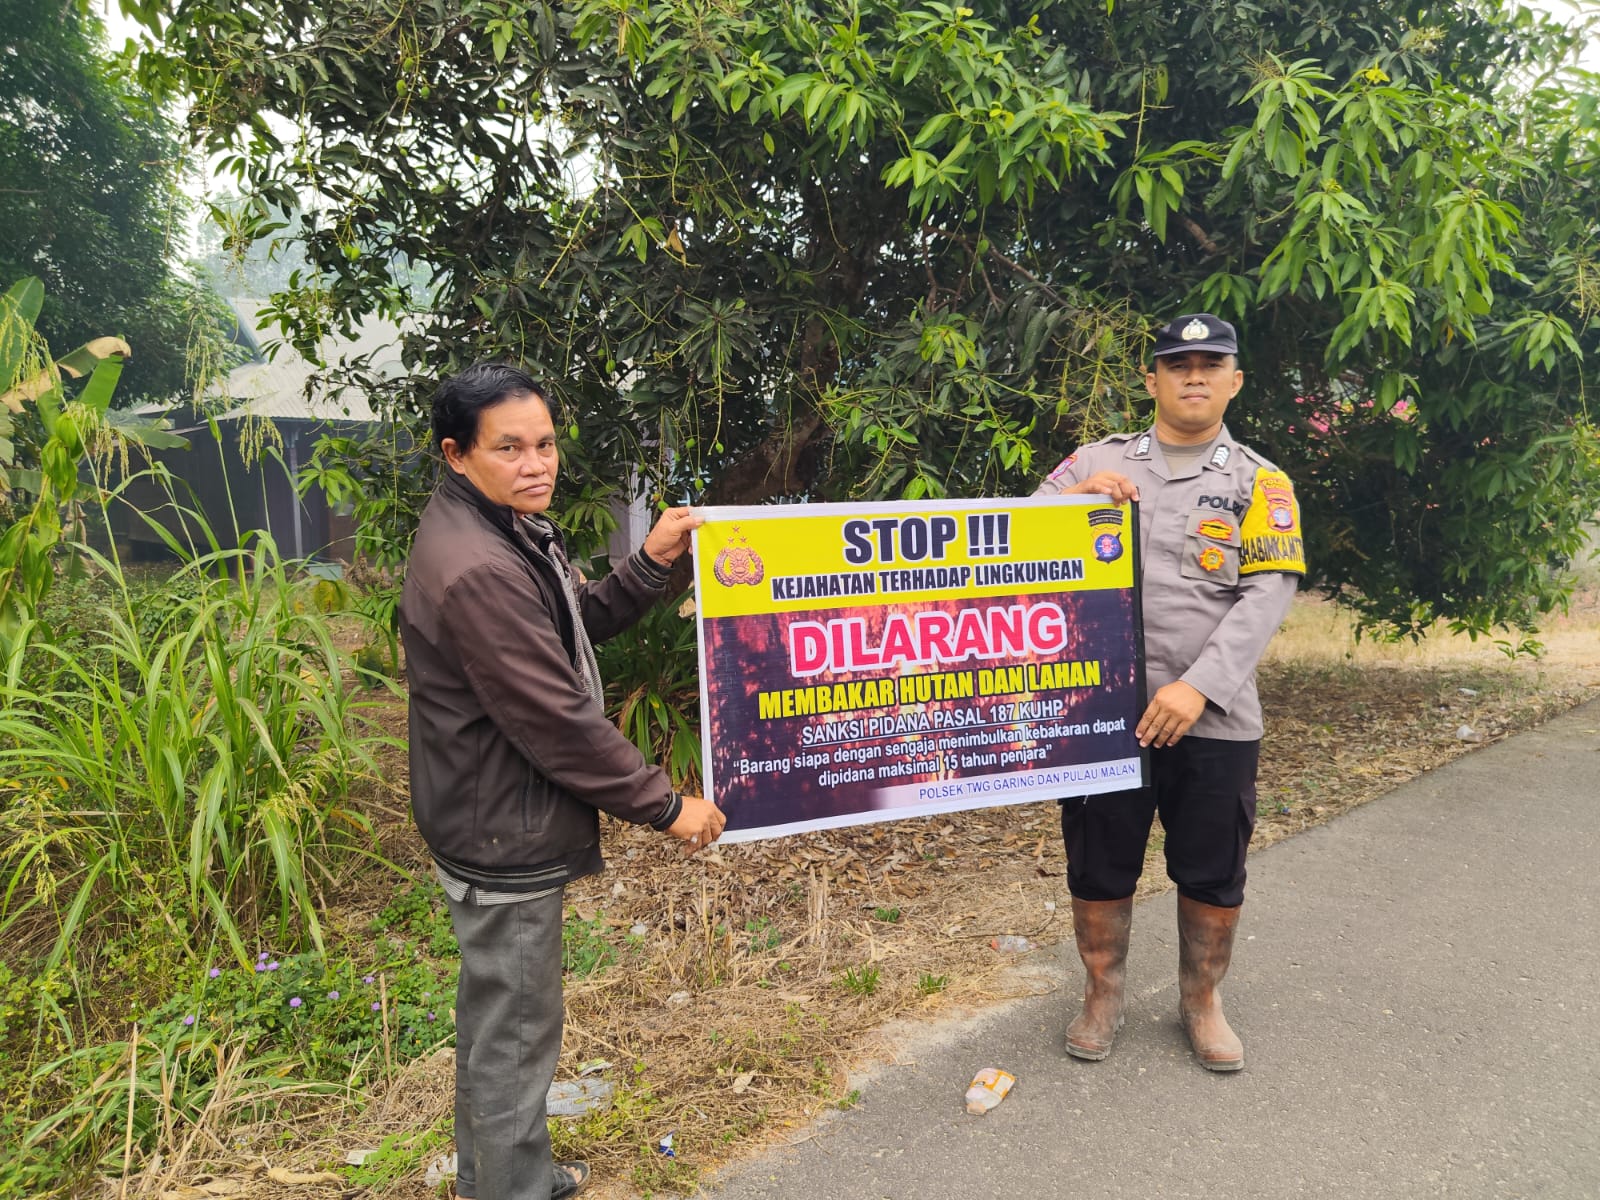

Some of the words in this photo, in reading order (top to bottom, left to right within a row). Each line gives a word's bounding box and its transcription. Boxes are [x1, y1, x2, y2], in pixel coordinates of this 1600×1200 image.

[844, 516, 956, 564] STOP
[967, 514, 1010, 556] !!!
[772, 572, 875, 600] KEJAHATAN
[879, 566, 970, 592] TERHADAP
[975, 559, 1083, 585] LINGKUNGAN
[791, 605, 1065, 674] DILARANG
[758, 679, 895, 720] MEMBAKAR
[899, 671, 974, 703] HUTAN
[978, 667, 1024, 696] DAN
[1028, 660, 1101, 691] LAHAN
[794, 751, 830, 769] siapa
[834, 746, 882, 764] dengan
[885, 738, 935, 758] sengaja
[939, 729, 1023, 751] menimbulkan
[1025, 722, 1090, 741] kebakaran
[1093, 717, 1126, 738] dapat
[802, 719, 864, 745] SANKSI
[869, 709, 931, 737] PIDANA
[933, 707, 986, 729] PASAL
[989, 703, 1014, 722] 187
[1018, 699, 1064, 720] KUHP
[818, 769, 875, 789] dipidana
[879, 758, 940, 779] maksimal
[943, 752, 959, 770] 15
[961, 748, 997, 768] tahun
[919, 785, 964, 800] POLSEK
[966, 780, 991, 794] TWG
[993, 774, 1035, 791] GARING
[1037, 771, 1061, 786] DAN
[1063, 768, 1098, 783] PULAU
[1099, 763, 1136, 778] MALAN
